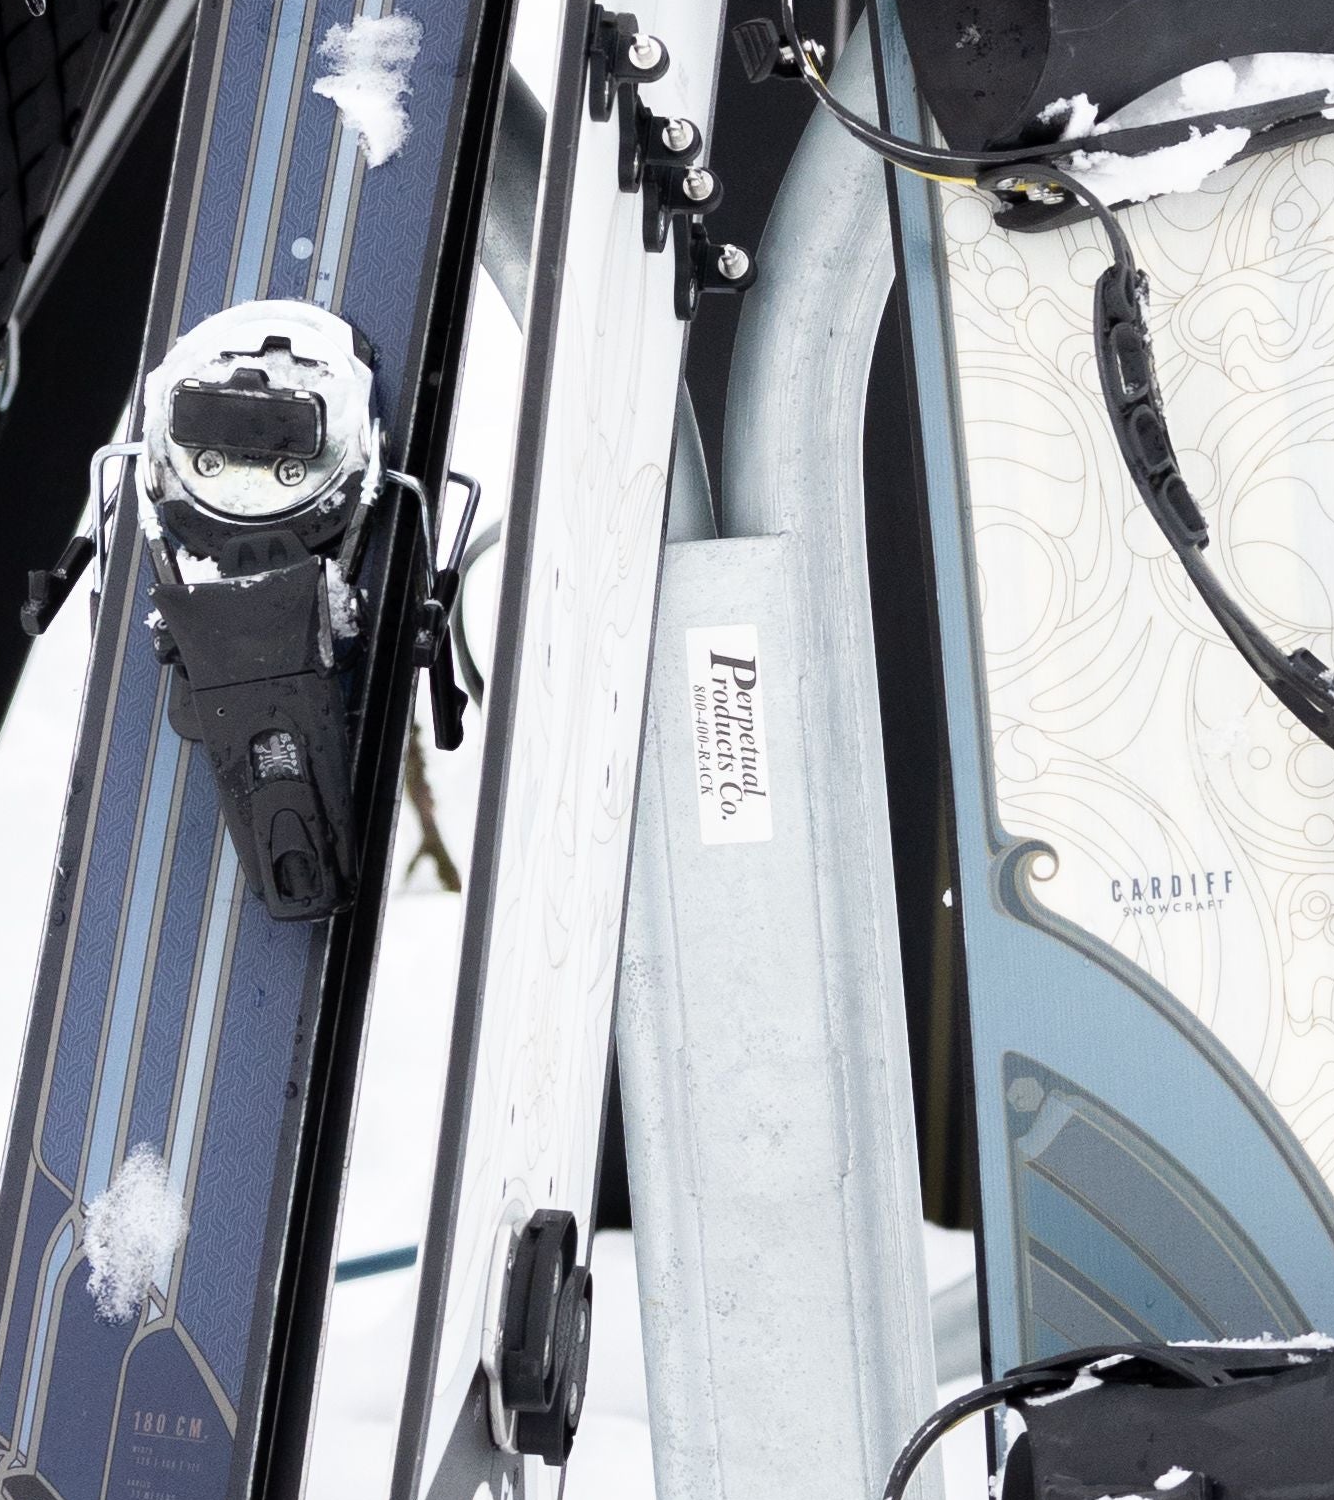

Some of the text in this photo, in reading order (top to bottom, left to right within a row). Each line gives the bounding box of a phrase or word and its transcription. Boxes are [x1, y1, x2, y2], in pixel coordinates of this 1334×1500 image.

[692, 684, 715, 796] 800-400-RACK
[709, 648, 767, 798] Perpetual
[719, 780, 744, 821] Co.
[1110, 870, 1234, 903] CARDIFF
[1122, 899, 1226, 918] SNOWCRAFT
[134, 1410, 167, 1434] 180
